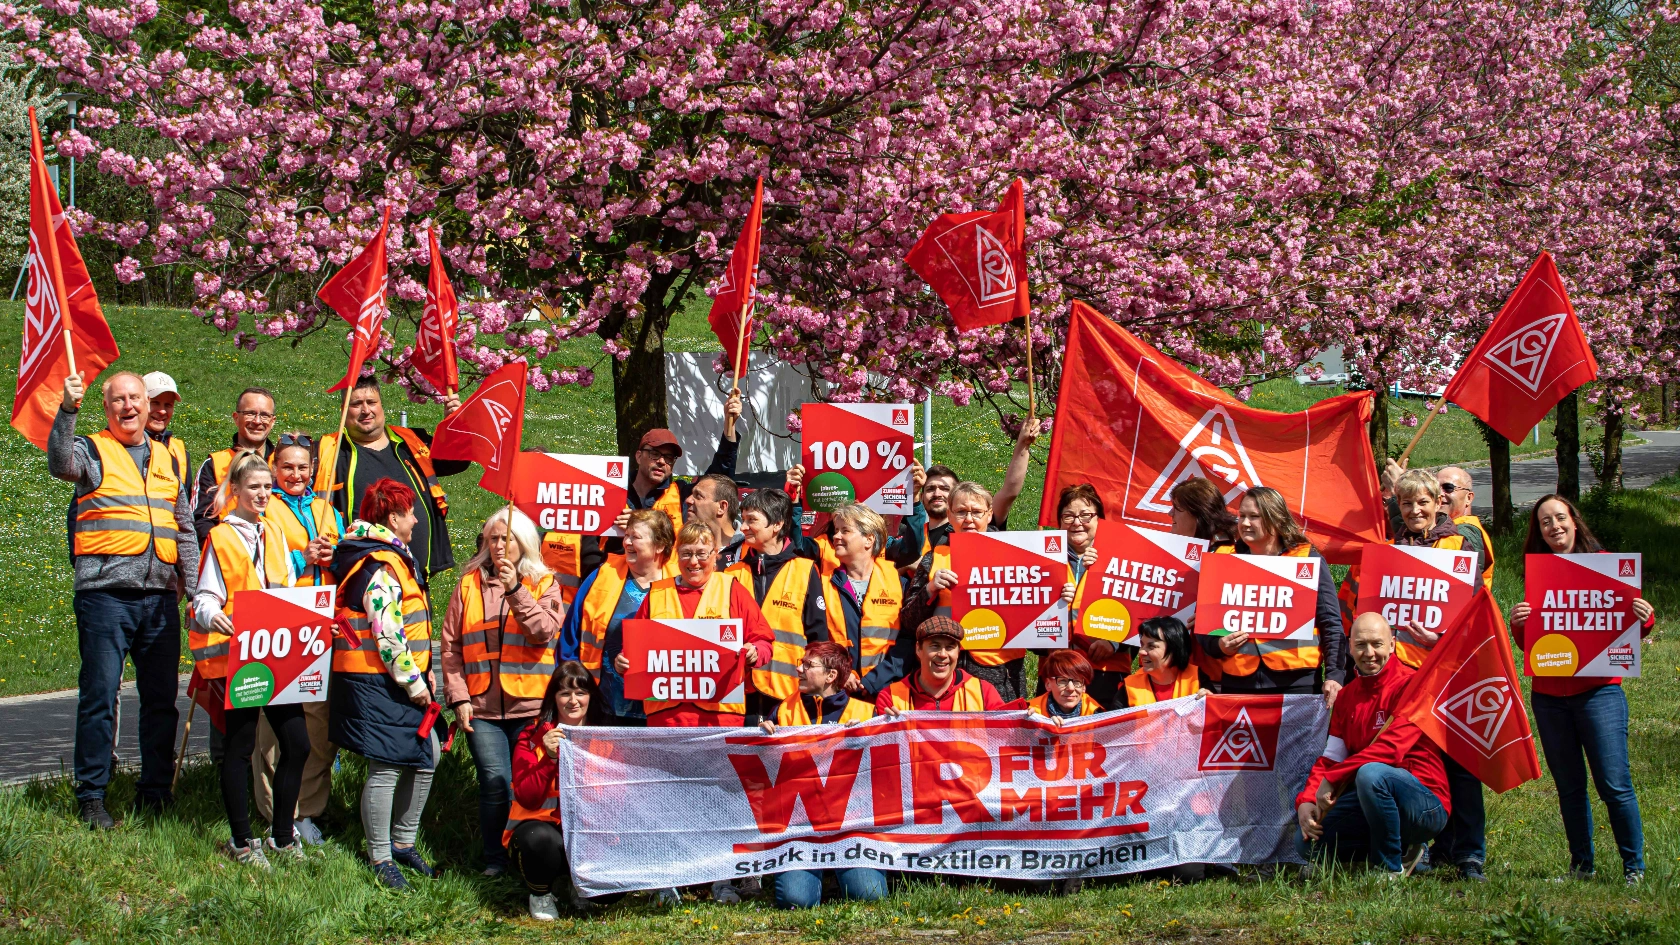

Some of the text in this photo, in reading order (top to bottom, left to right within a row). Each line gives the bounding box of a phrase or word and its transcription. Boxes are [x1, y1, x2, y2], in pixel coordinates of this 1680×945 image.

[808, 440, 906, 470] 100 %
[536, 482, 606, 506] MEHR
[540, 508, 600, 532] GELD
[968, 566, 1050, 585] ALTERS-
[1104, 557, 1185, 587] ALTERS-
[966, 586, 1052, 606] TEILZEIT
[1102, 576, 1184, 610] TEILZEIT
[1220, 583, 1294, 608] MEHR
[1380, 575, 1450, 602] MEHR
[1542, 590, 1624, 608] ALTERS-
[1222, 610, 1287, 634] GELD
[1382, 602, 1442, 628] GELD
[1540, 612, 1625, 630] TEILZEIT
[236, 626, 325, 660] 100 %
[647, 650, 720, 672] MEHR
[1536, 652, 1572, 660] Tarifvertrag
[1538, 658, 1572, 668] verlängern!
[652, 676, 716, 700] GELD
[999, 736, 1108, 783] FÜR
[727, 740, 996, 834] WIR
[1000, 780, 1149, 822] MEHR
[734, 842, 1146, 876] Stark in den Textilen Branchen
